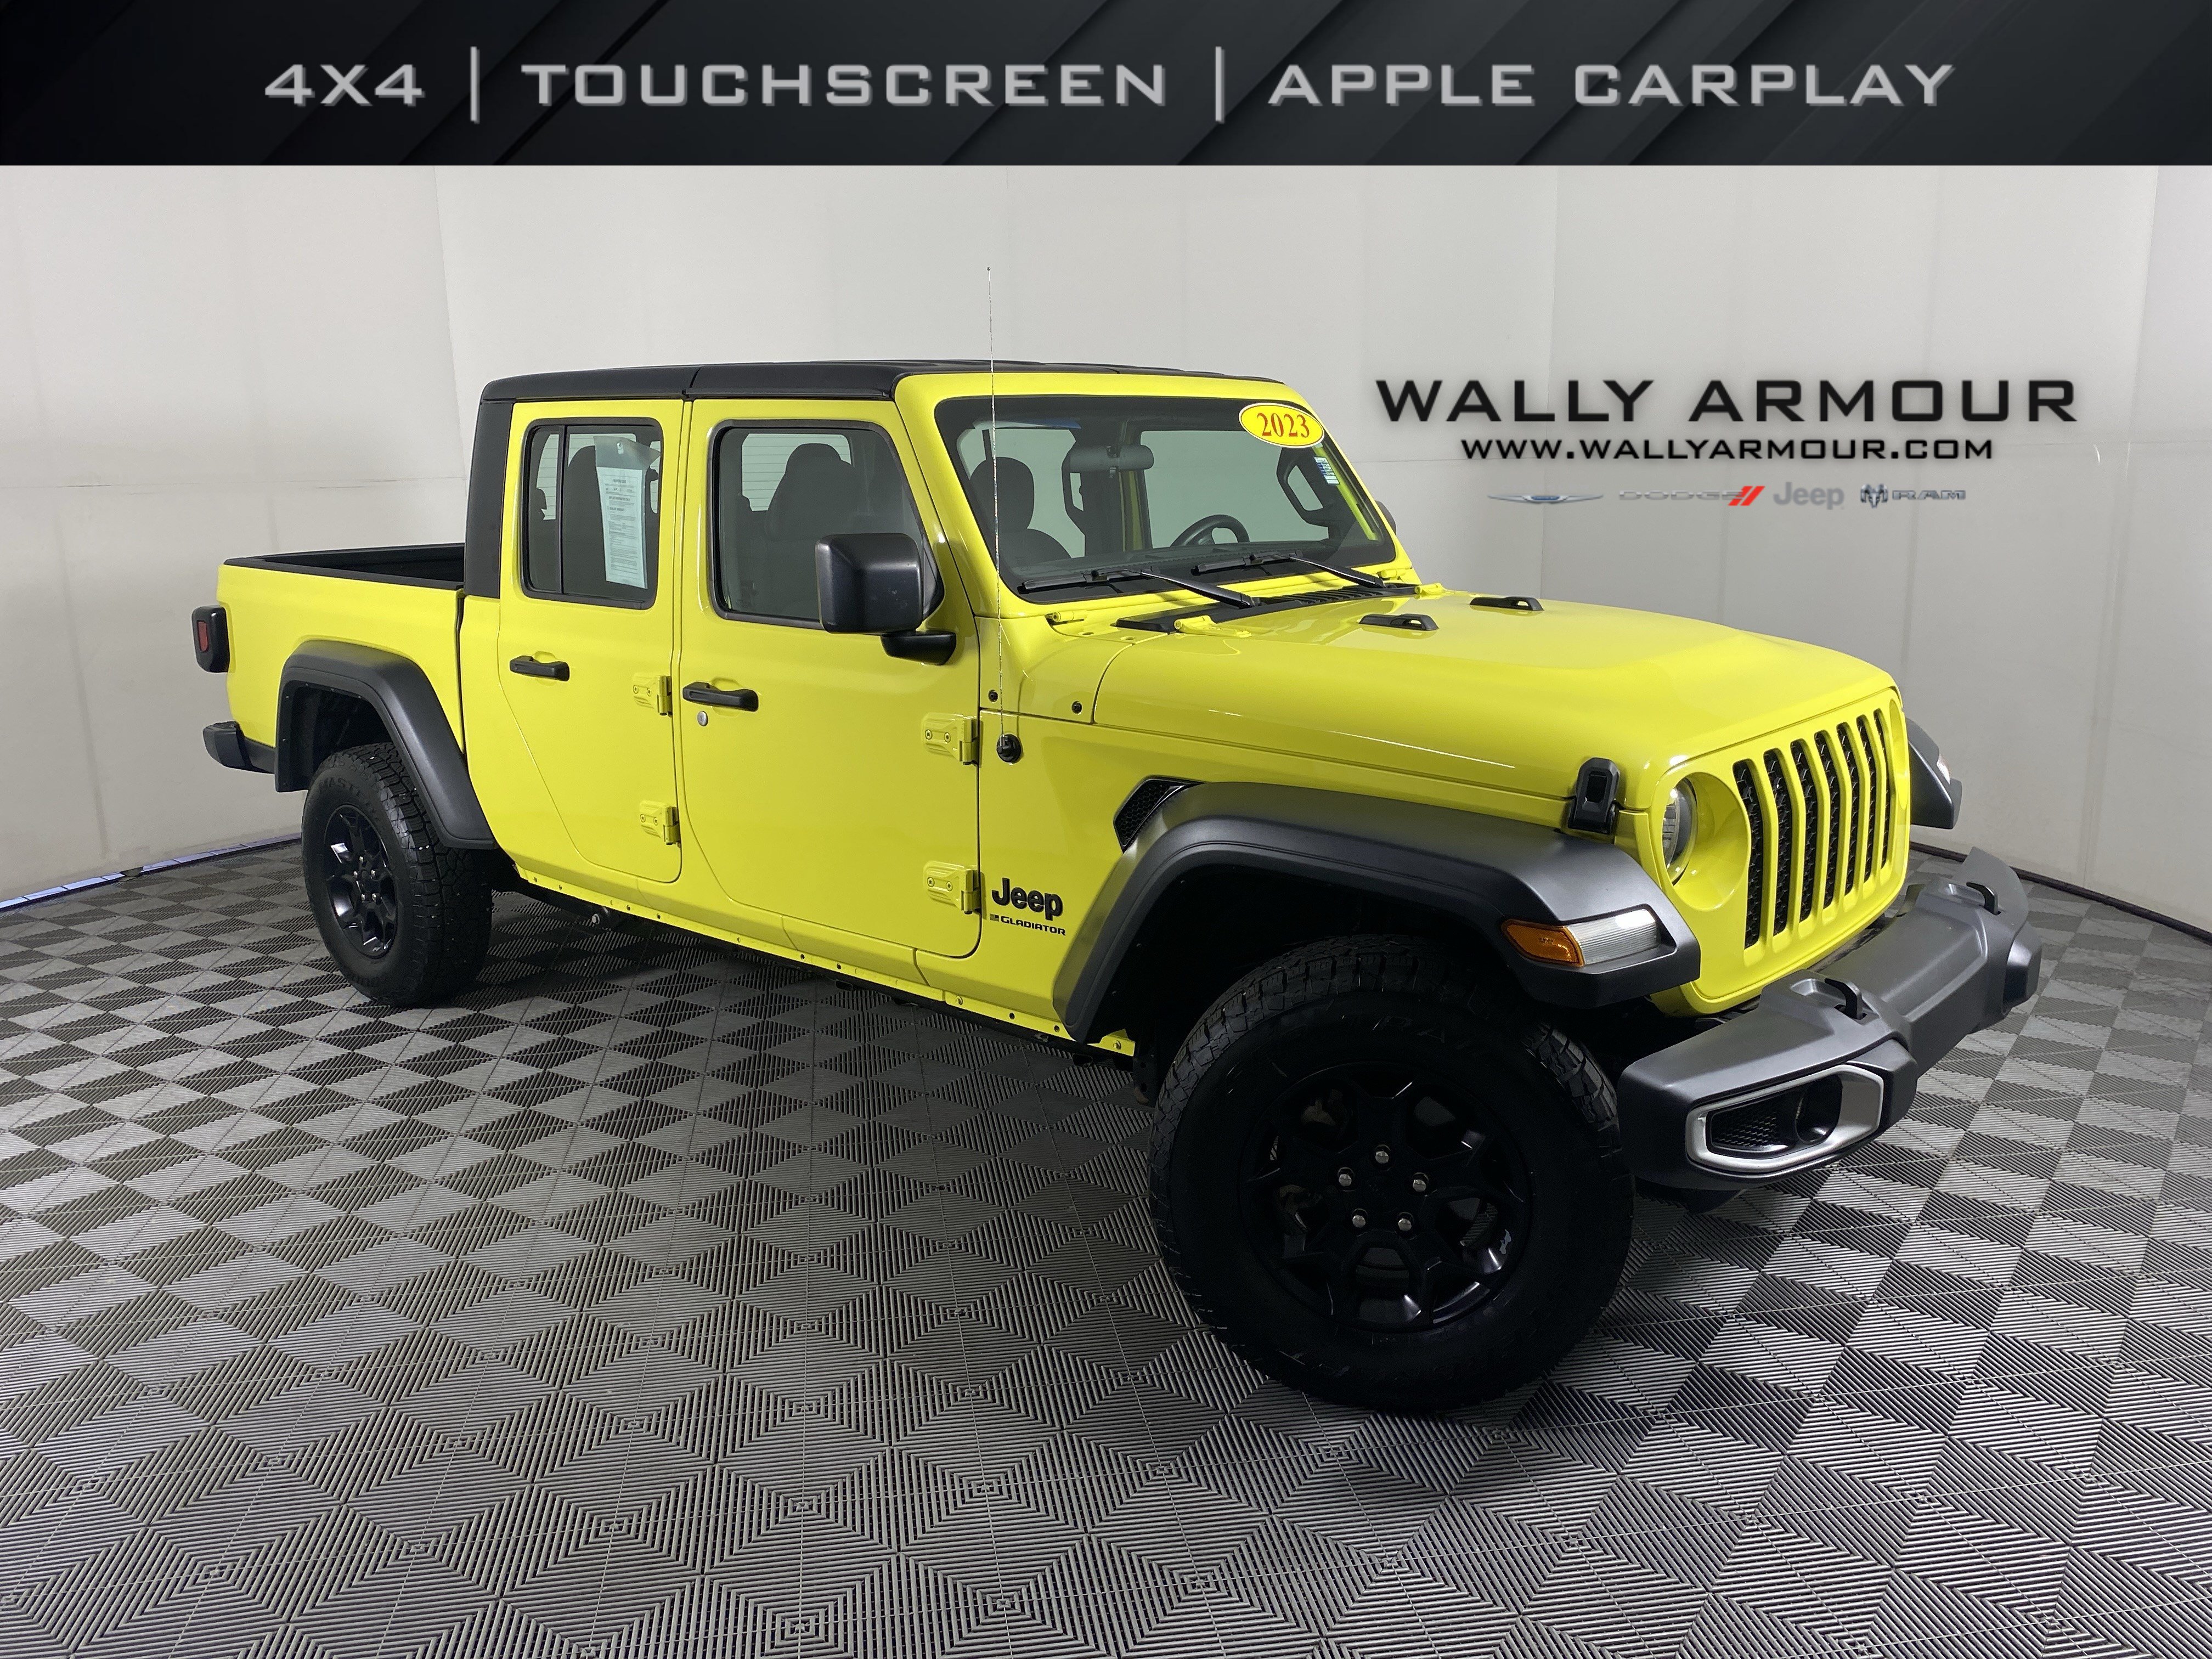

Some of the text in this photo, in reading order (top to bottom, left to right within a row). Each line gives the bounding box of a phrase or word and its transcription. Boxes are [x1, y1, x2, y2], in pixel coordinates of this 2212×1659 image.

[1257, 413, 1310, 438] 2023
[991, 877, 1063, 921] Jeep
[1000, 916, 1066, 936] GLADIATOR
